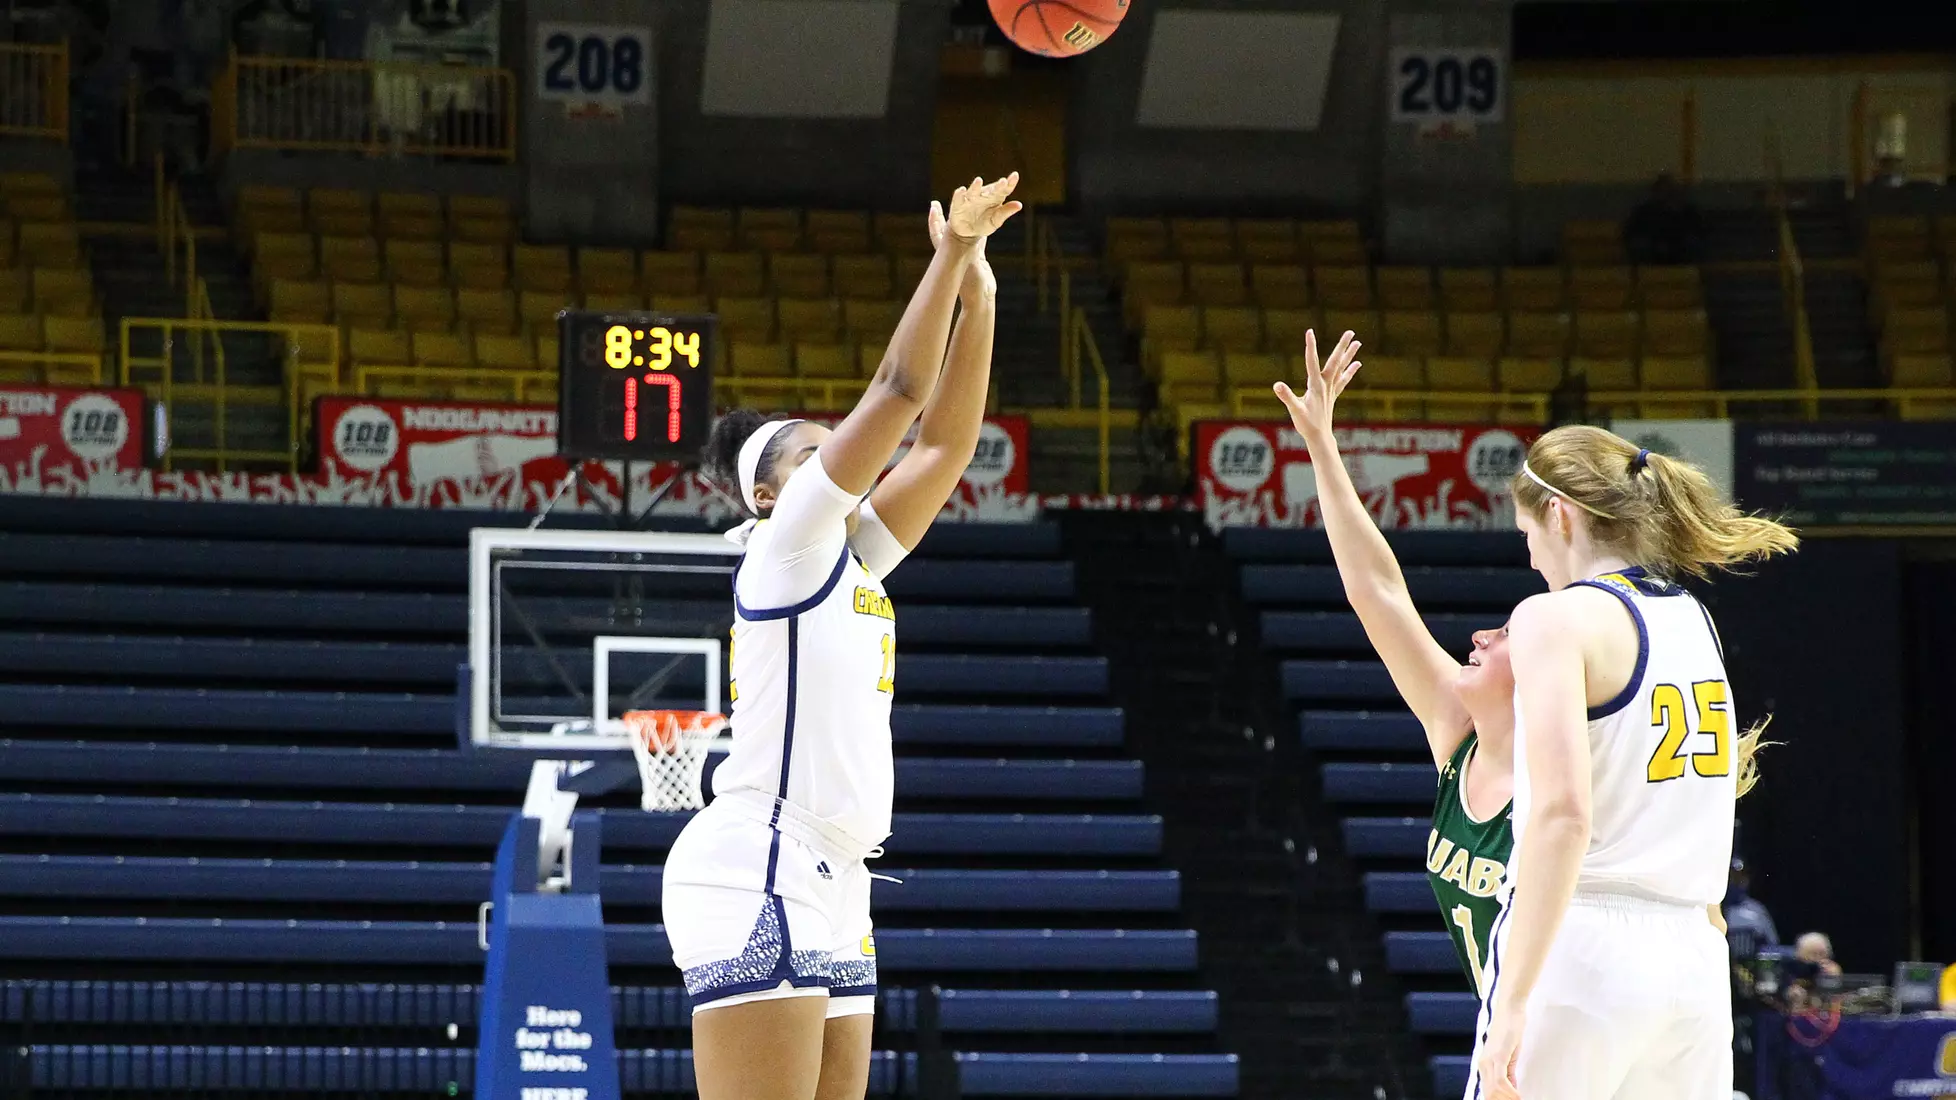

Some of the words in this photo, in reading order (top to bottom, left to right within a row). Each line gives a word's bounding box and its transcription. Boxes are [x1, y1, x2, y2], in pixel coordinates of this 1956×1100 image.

[545, 31, 643, 94] 208
[1401, 56, 1498, 114] 209
[605, 325, 700, 371] 8:34
[402, 406, 559, 434] NOOGANATI
[624, 373, 682, 443] 17
[344, 420, 391, 443] 108
[975, 437, 1005, 458] 08
[1647, 679, 1731, 783] 25
[1426, 828, 1506, 898] UAB
[526, 1005, 582, 1028] Here
[515, 1027, 551, 1050] for
[552, 1028, 593, 1050] the
[520, 1050, 588, 1073] Mocs.
